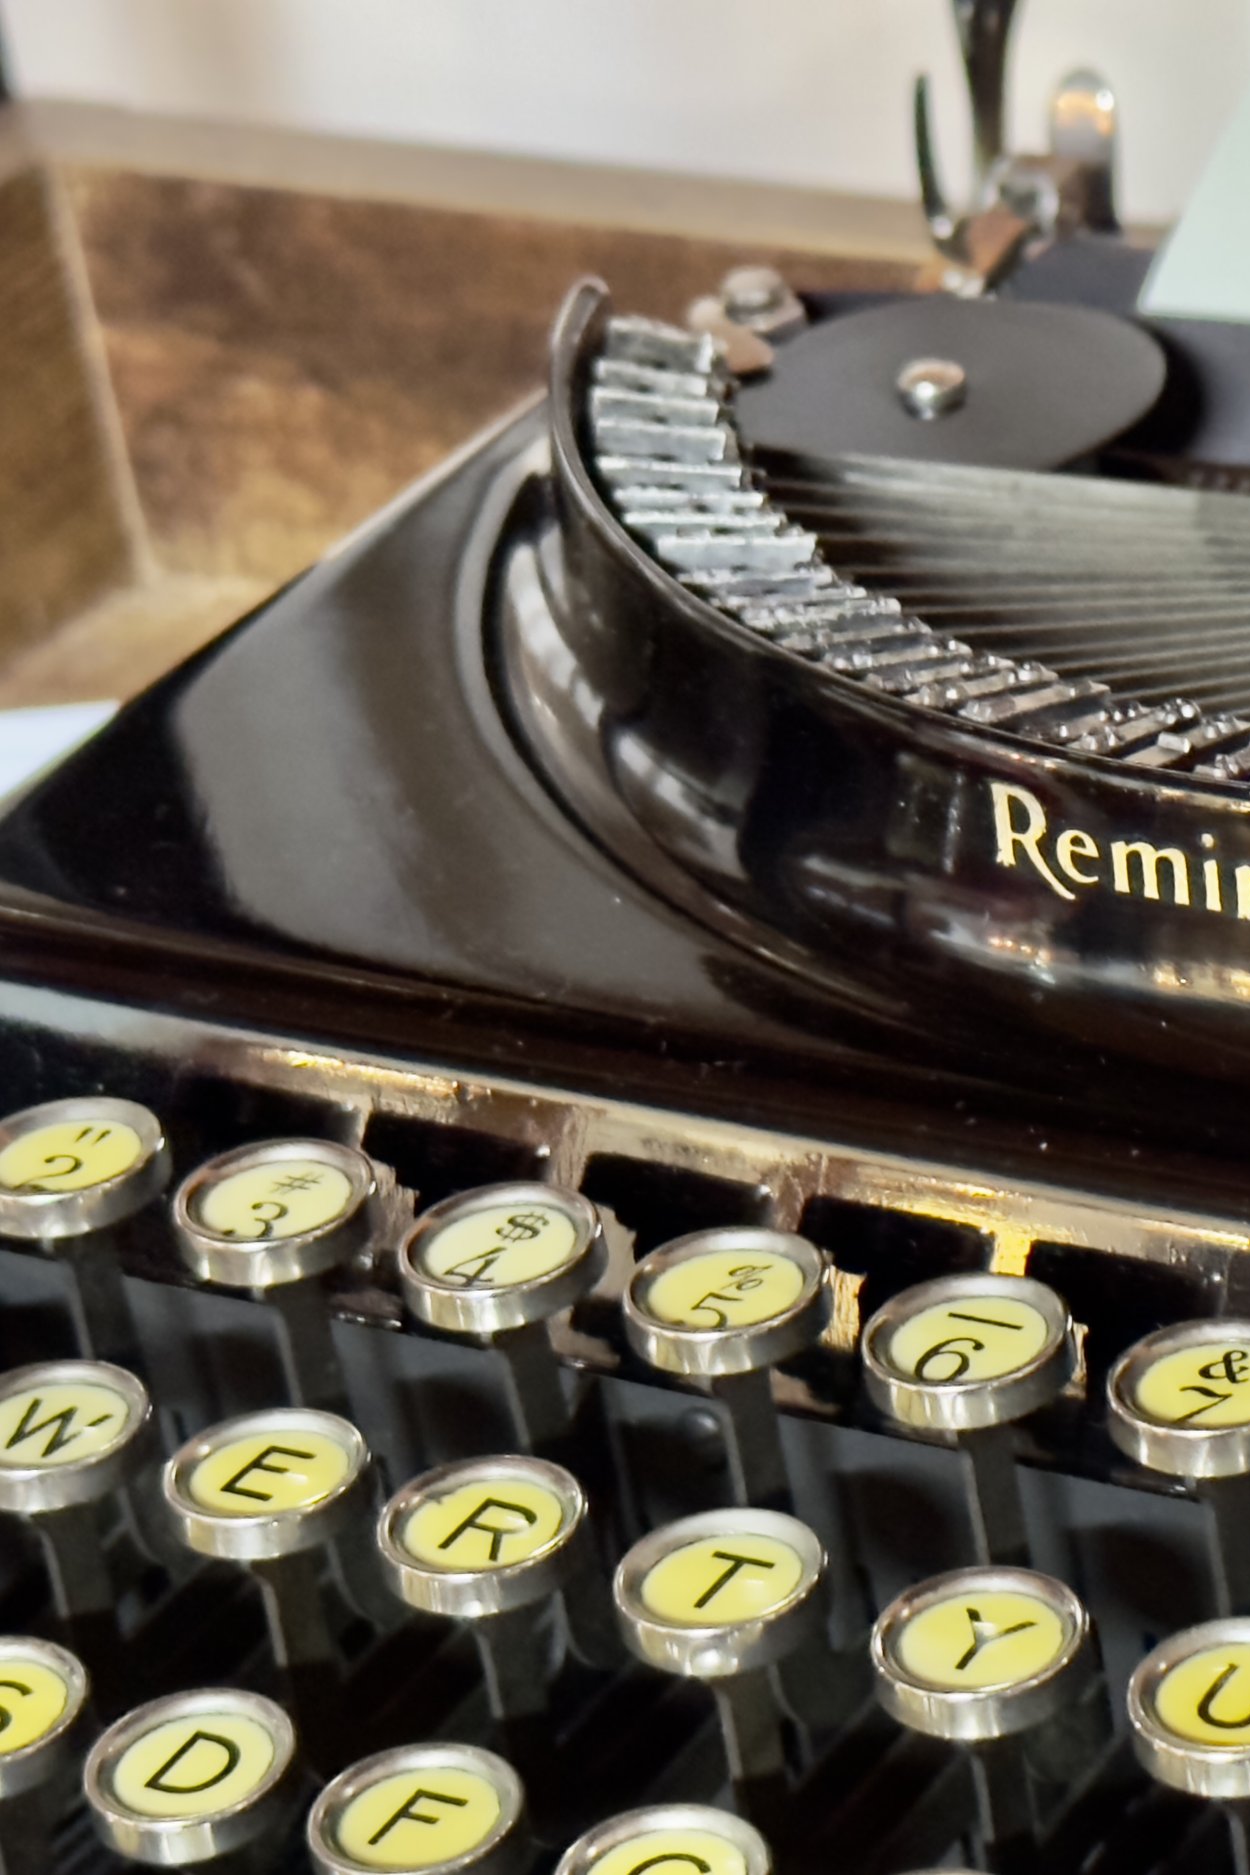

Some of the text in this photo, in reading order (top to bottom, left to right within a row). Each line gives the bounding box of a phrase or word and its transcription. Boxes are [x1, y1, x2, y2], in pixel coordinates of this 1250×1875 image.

[11, 1153, 82, 1191] 2
[272, 1170, 322, 1194] #
[222, 1200, 289, 1240] 3
[495, 1211, 551, 1243] $
[441, 1246, 508, 1290] 4
[723, 1262, 774, 1293] %
[677, 1290, 741, 1330] 5
[912, 1335, 987, 1384] 6
[1197, 1348, 1250, 1385] &
[1170, 1383, 1236, 1425] 7
[4, 1396, 116, 1460] W
[219, 1444, 319, 1502] E
[437, 1496, 540, 1562] R
[693, 1549, 777, 1609] T
[955, 1607, 1039, 1671] Y
[143, 1729, 242, 1795] D
[367, 1786, 470, 1847] F
